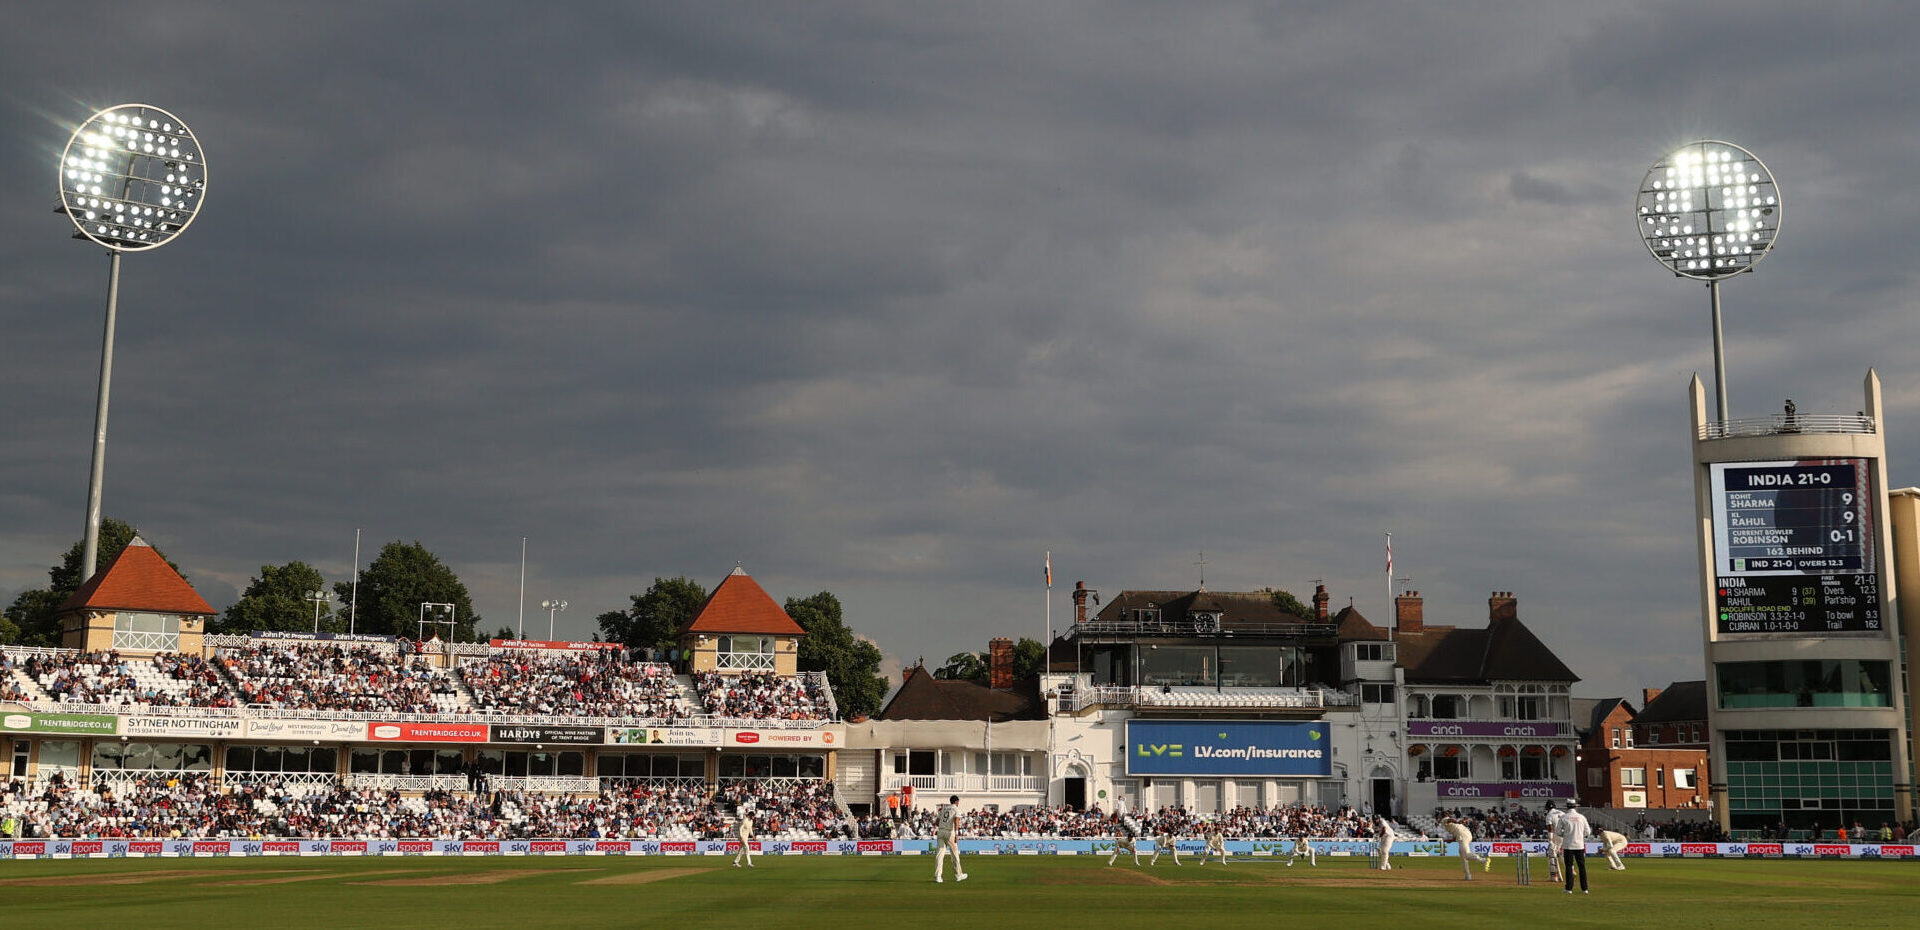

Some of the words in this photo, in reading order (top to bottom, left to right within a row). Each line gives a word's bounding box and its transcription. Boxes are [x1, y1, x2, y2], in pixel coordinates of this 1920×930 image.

[1748, 475, 1794, 486] INDIA
[1798, 473, 1831, 485] 21-0
[1731, 499, 1775, 508] SHARMA
[1842, 493, 1852, 505] 9
[1843, 511, 1854, 523] 9
[1732, 518, 1766, 526] RAHUL
[1733, 536, 1788, 544] ROBINSON
[1830, 530, 1853, 542] 0-1
[1766, 548, 1784, 556] 162
[1786, 547, 1823, 555] BEHIND
[1752, 560, 1768, 568] IND
[1719, 578, 1746, 587] INDIA
[1855, 575, 1875, 585] 21-0
[1734, 588, 1766, 596] SHARMA
[1792, 588, 1797, 596] 9
[1824, 586, 1845, 595] Overs
[1860, 586, 1876, 594] 12.3
[1728, 598, 1752, 606] RAHUL
[1792, 597, 1797, 606] 9
[1867, 596, 1876, 604] 21
[1729, 612, 1766, 621] ROBINSON
[1825, 611, 1835, 619] To
[1837, 610, 1854, 619] bowl
[1866, 610, 1877, 619] 9.3
[1729, 622, 1759, 630] CURRAN
[1826, 620, 1843, 629] Trail
[1865, 620, 1878, 629] 162
[278, 631, 291, 640] Pye
[334, 633, 350, 641] John
[363, 635, 387, 643] Property
[39, 719, 112, 729] TRENTBRIDGE.CO.UK
[128, 718, 169, 728] SYTNER
[171, 719, 239, 729] NOTTINGHAM
[250, 721, 268, 732] David
[269, 721, 284, 732] Lloyd
[331, 723, 348, 733] David
[349, 724, 363, 734] Lloyd
[410, 729, 481, 737] TRENTBRIDGE.CO.UK
[1431, 723, 1463, 735] cinch
[1504, 724, 1535, 736] cinch
[500, 730, 540, 738] HARDYS
[1194, 746, 1322, 760] LV.com/insurance
[1448, 784, 1480, 796] cinch
[1521, 785, 1553, 797] cinch
[943, 811, 950, 823] 9
[0, 844, 11, 854] ky
[14, 846, 45, 854] sports
[56, 843, 71, 854] sky
[73, 844, 102, 854] sports
[112, 843, 127, 854] sky
[130, 844, 161, 854] sports
[174, 843, 191, 852] sky
[194, 844, 229, 852] sports
[243, 843, 261, 852] sky
[264, 844, 299, 852] sports
[312, 843, 329, 852] sky
[332, 843, 365, 852] sports
[379, 843, 396, 852] sky
[399, 843, 431, 852] sports
[444, 843, 461, 852] sky
[465, 843, 498, 852] sports
[511, 843, 528, 852] sky
[532, 843, 564, 852] sports
[577, 843, 594, 852] sky
[597, 843, 630, 852] sports
[642, 843, 659, 852] sky
[662, 844, 694, 852] sports
[708, 843, 724, 852] sky
[773, 843, 790, 852] sky
[793, 843, 825, 852] sports
[839, 843, 855, 852] sky
[858, 843, 891, 852] sports
[1475, 844, 1491, 854] sky
[1662, 845, 1679, 854] sky
[1683, 845, 1715, 854] sports
[1729, 845, 1746, 855] sky
[1795, 845, 1812, 855] sky
[1816, 846, 1848, 855] sports
[1862, 846, 1879, 855] sky
[1883, 846, 1913, 855] sports
